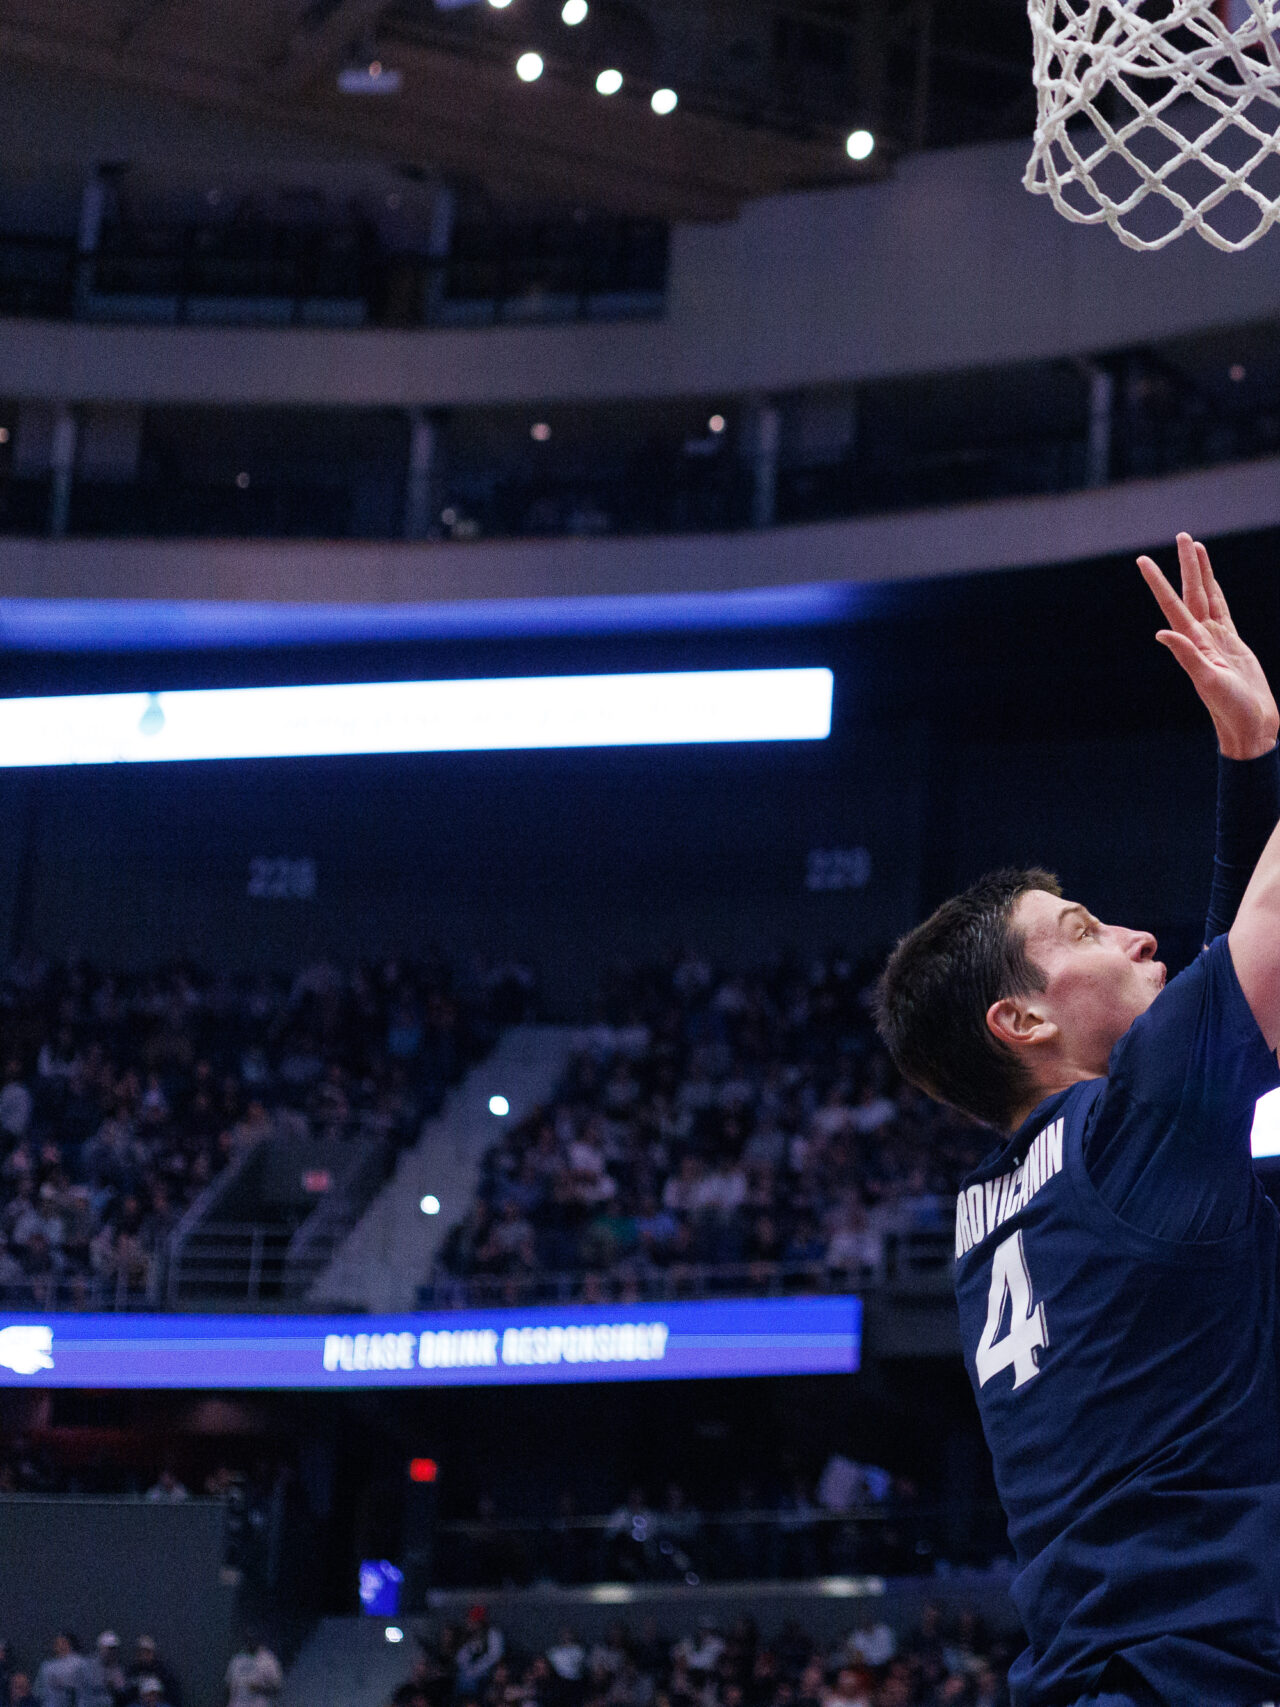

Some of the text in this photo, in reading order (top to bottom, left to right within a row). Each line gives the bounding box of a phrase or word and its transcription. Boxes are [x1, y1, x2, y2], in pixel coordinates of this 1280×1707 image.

[323, 1321, 669, 1372] PLEASE DRINK RESPONSIBLY
[975, 1229, 1050, 1391] 4
